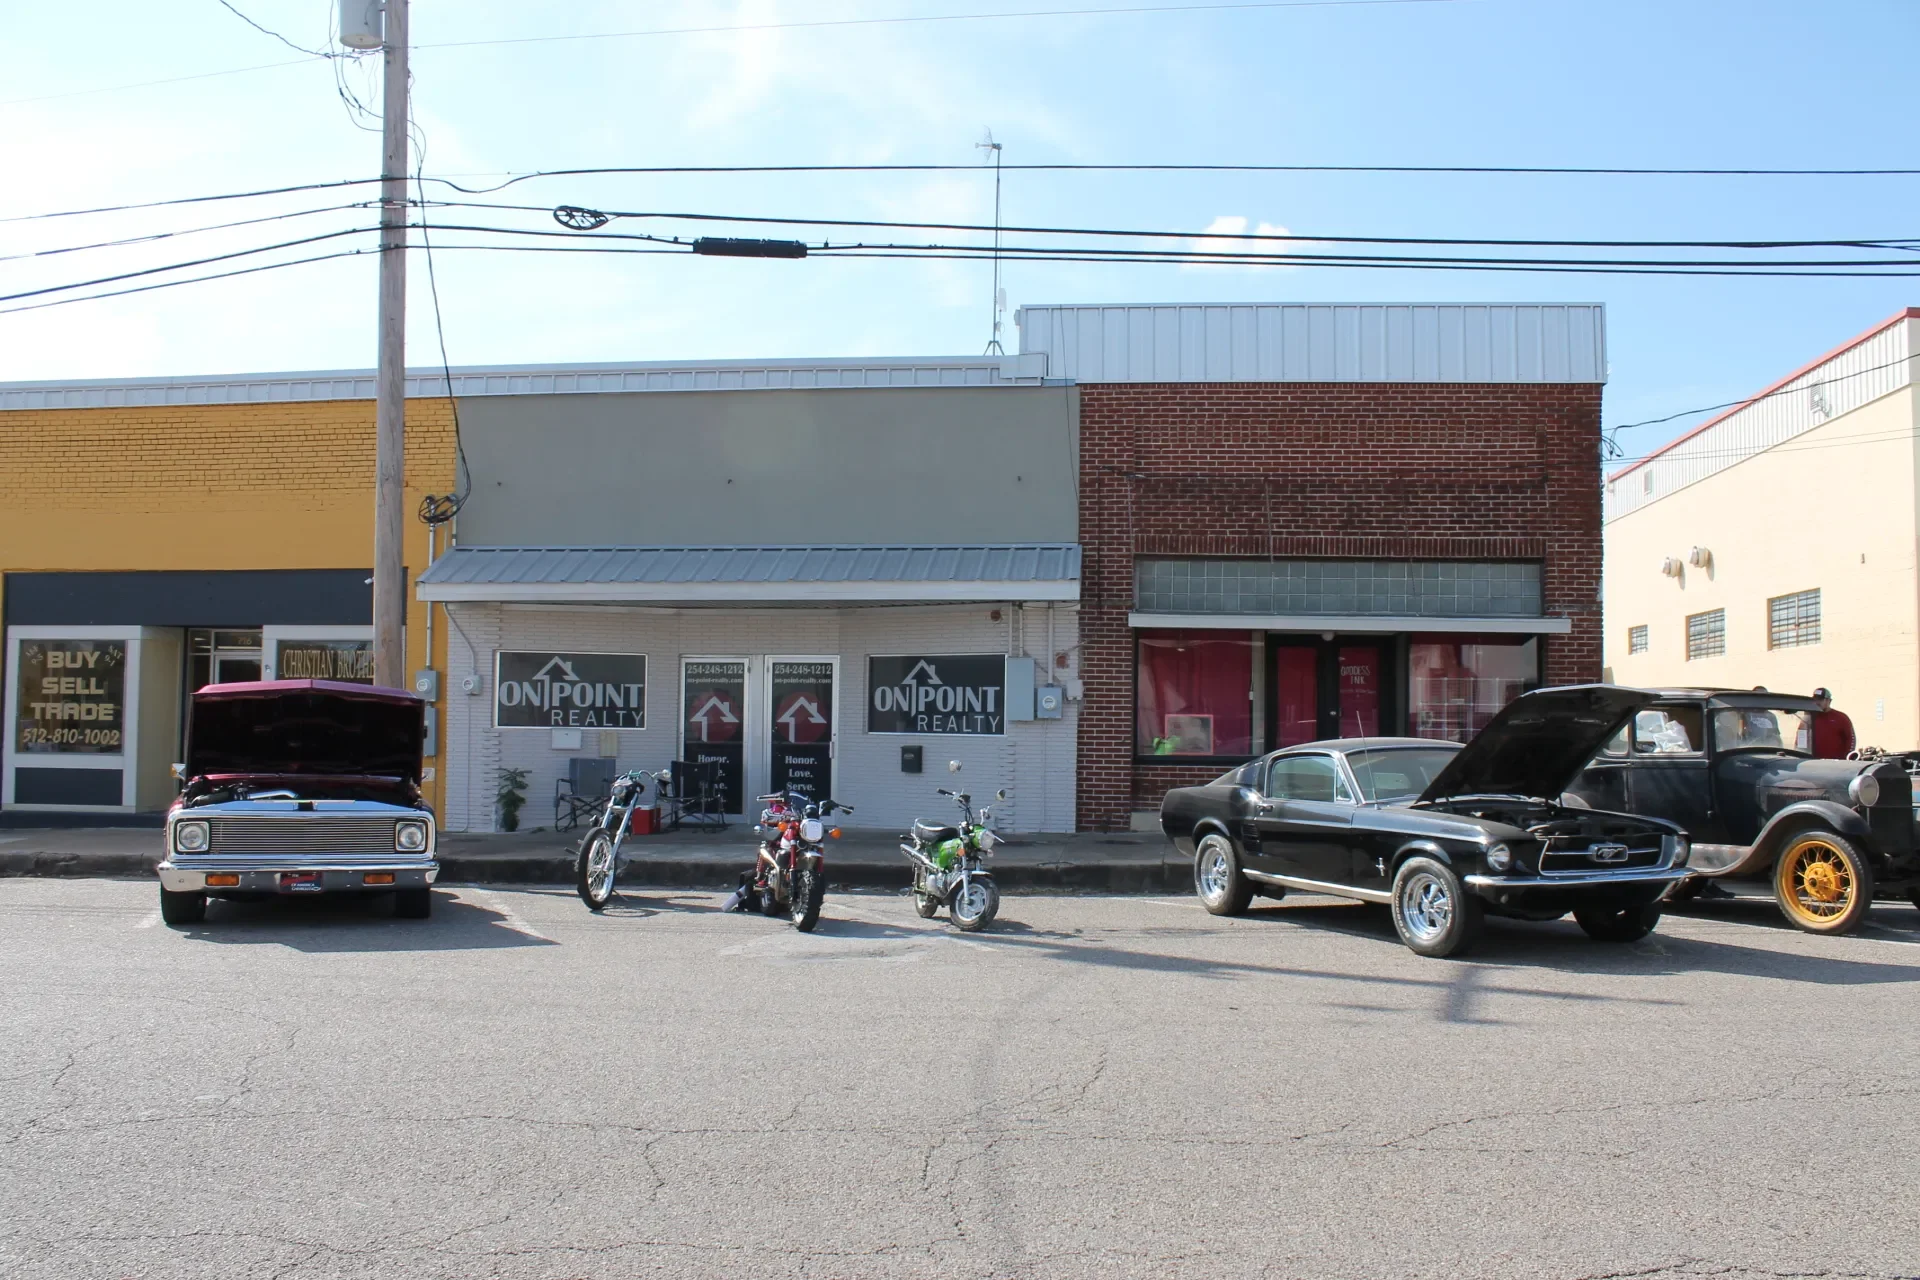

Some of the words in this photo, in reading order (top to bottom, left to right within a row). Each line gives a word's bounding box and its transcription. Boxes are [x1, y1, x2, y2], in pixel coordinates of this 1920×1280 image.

[46, 651, 101, 668] BUY
[283, 649, 334, 678] CHRISTIAN
[41, 677, 105, 695] SELL
[1350, 675, 1366, 685] INK
[499, 681, 541, 707] ON
[552, 682, 644, 708] POINT
[874, 686, 909, 712] ON
[918, 686, 1000, 713] POINT
[30, 702, 115, 721] TRADE
[551, 709, 644, 727] REALTY
[917, 715, 1000, 733] REALTY
[22, 728, 120, 745] 512-810-1002
[785, 755, 818, 765] Honor.
[788, 768, 813, 778] Love.
[786, 782, 816, 791] Serve.
